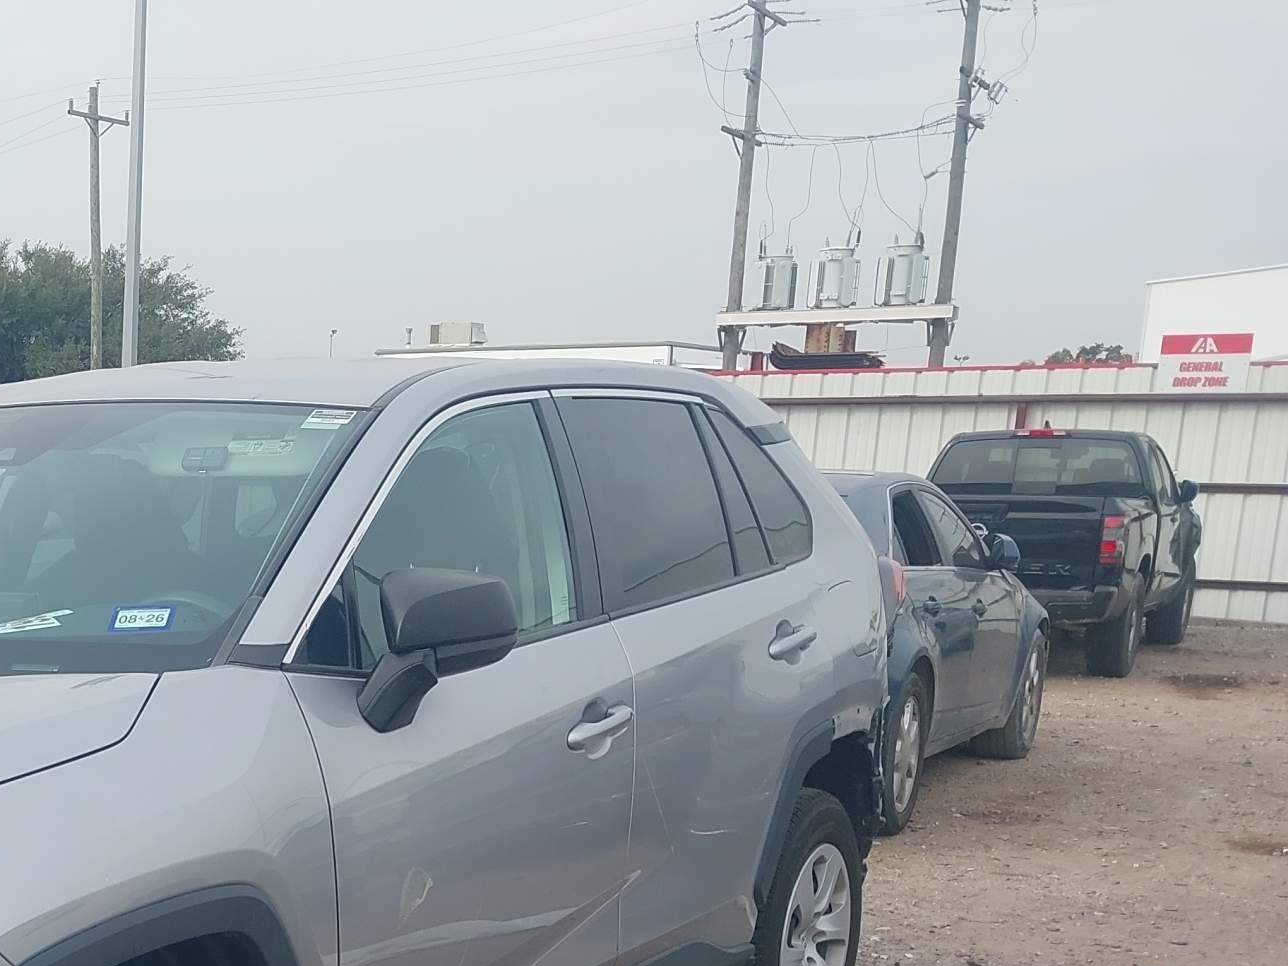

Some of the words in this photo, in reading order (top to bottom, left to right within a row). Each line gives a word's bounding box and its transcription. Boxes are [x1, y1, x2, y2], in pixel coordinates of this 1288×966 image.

[1179, 361, 1223, 373] GENERAL
[1172, 376, 1201, 388] DROP
[1202, 376, 1229, 388] ZONE
